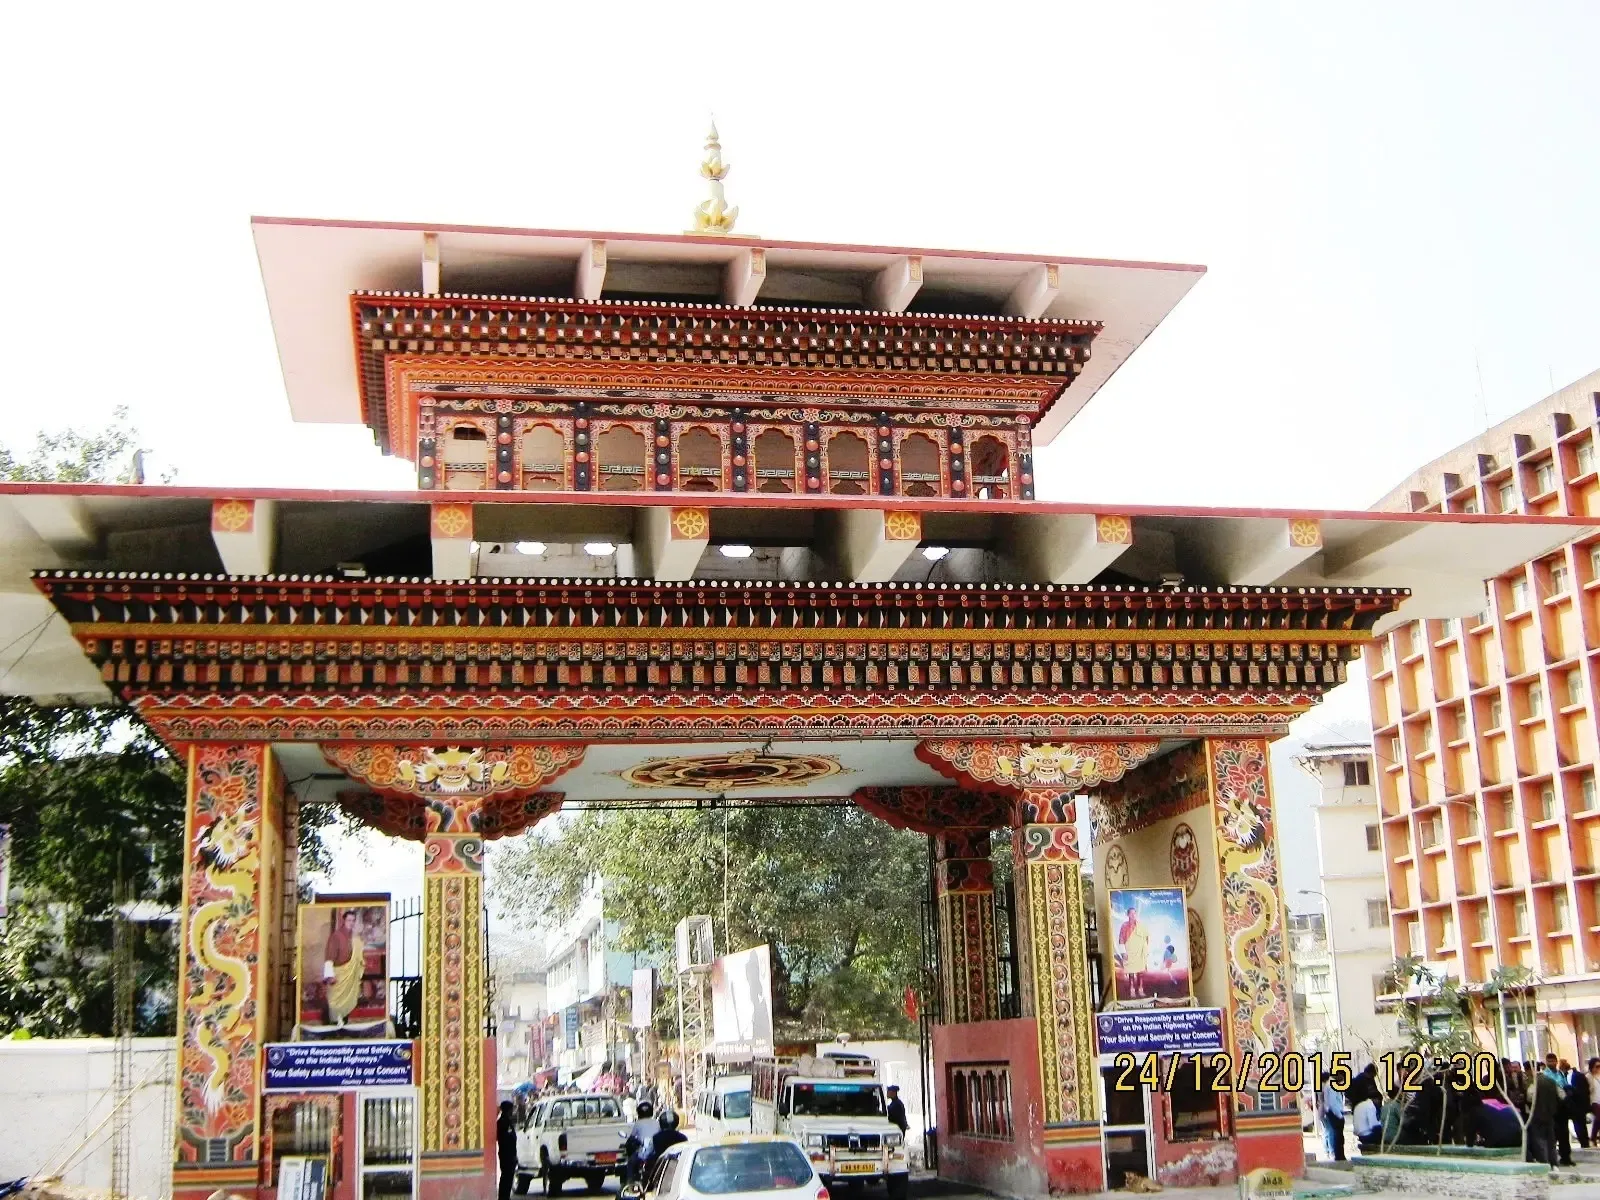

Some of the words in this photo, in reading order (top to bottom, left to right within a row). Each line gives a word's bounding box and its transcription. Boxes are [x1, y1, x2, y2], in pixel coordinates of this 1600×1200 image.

[1135, 1015, 1172, 1024] Responsibly
[1118, 1035, 1136, 1044] Safety
[1138, 1034, 1149, 1042] and
[1149, 1033, 1173, 1042] Security
[310, 1046, 354, 1056] Responsibly
[355, 1046, 369, 1055] and
[371, 1045, 393, 1055] Safety
[295, 1057, 305, 1065] on
[306, 1056, 318, 1065] the
[319, 1055, 341, 1064] Indian
[287, 1068, 310, 1079] Safety
[311, 1068, 325, 1077] and
[325, 1067, 355, 1078] Security
[355, 1067, 361, 1075] is
[363, 1067, 375, 1075] our
